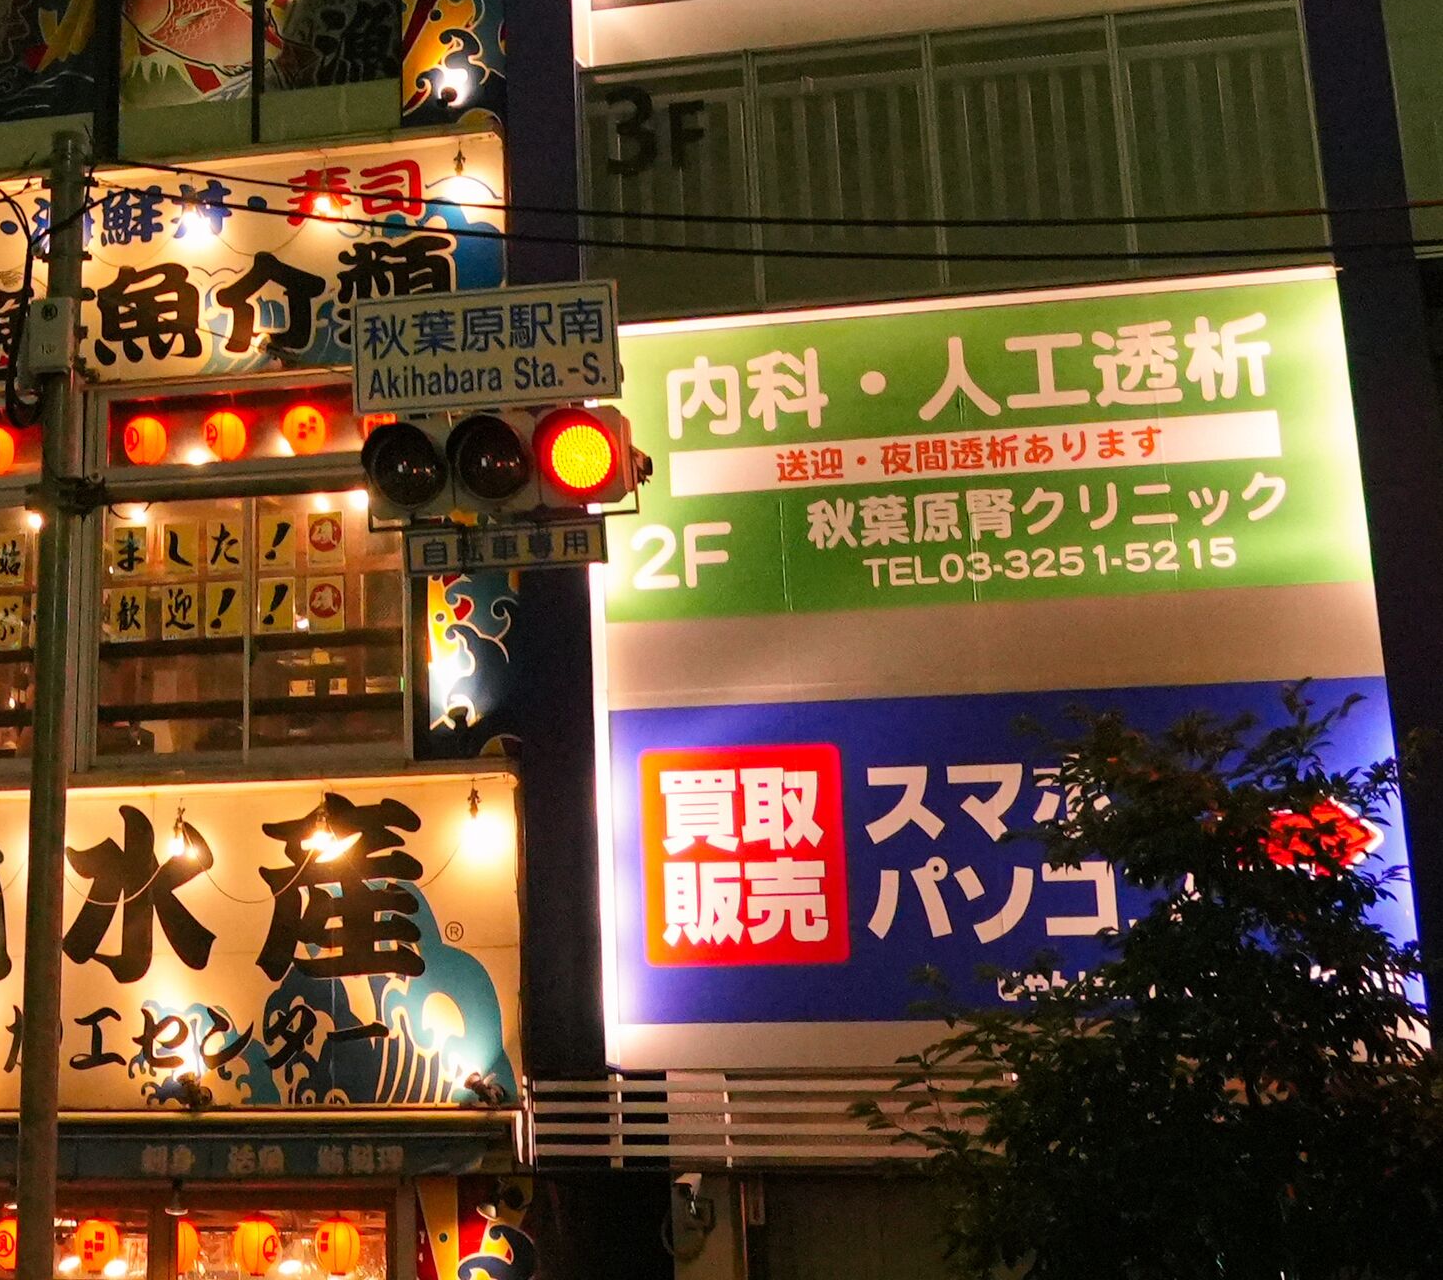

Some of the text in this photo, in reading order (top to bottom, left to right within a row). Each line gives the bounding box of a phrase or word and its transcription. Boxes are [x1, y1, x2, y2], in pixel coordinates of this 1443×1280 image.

[604, 84, 707, 178] 3F
[363, 298, 604, 360] 秋葉原駅南
[369, 363, 502, 400] Akihabara
[665, 312, 1270, 440] 内科・人工透析
[776, 426, 1163, 484] 送迎・夜間透析あります
[806, 471, 1288, 550] 秋葉原腎クリニック
[629, 520, 732, 592] 2F
[659, 768, 824, 853] 買取
[662, 860, 829, 946] 販売
[867, 855, 1202, 944] パソコ
